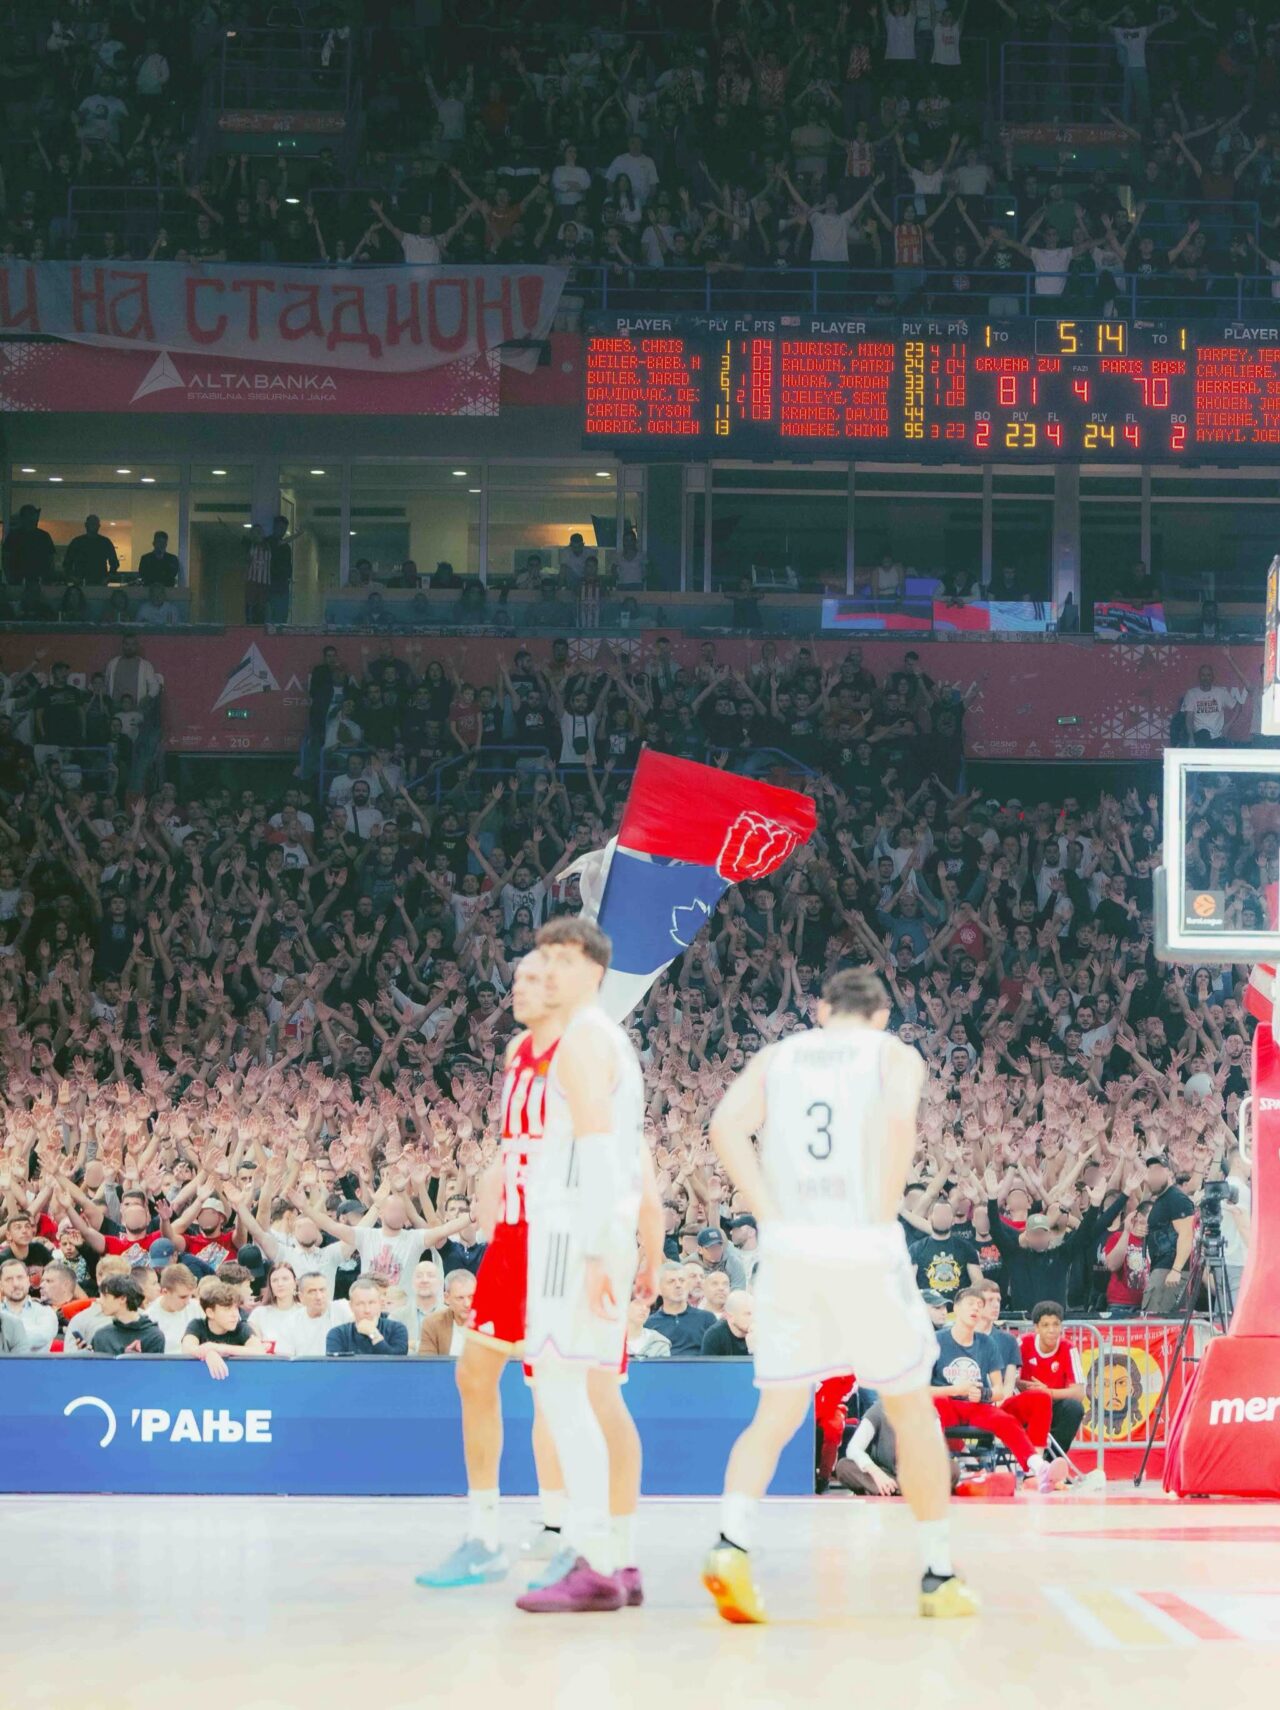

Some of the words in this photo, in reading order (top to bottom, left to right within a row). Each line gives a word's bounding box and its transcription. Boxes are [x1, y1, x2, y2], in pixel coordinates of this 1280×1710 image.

[617, 319, 671, 331] PLAYER
[709, 321, 728, 331] PLY
[735, 321, 748, 331] FL
[754, 321, 775, 331] PTS
[811, 322, 865, 333] PLAYER
[903, 324, 921, 335] PLY
[929, 324, 942, 335] FL
[948, 324, 968, 335] PTS
[986, 326, 990, 347] 1
[993, 332, 1008, 341] TO
[1152, 335, 1167, 344] TO
[1181, 329, 1185, 350] 1
[1225, 329, 1278, 339] PLAYER
[589, 339, 636, 352] JONES,
[642, 339, 683, 352] CHRIS
[753, 340, 771, 354] 04
[905, 343, 924, 357] 23
[952, 344, 965, 356] 11
[587, 355, 686, 369] WEILER-BABB,
[721, 356, 730, 370] 3
[753, 356, 771, 370] 03
[1197, 349, 1252, 362] TARPEY,
[782, 359, 845, 372] BALDWIN,
[905, 359, 924, 373] 24
[947, 360, 965, 374] 04
[976, 359, 1029, 372] CRVENA
[1102, 360, 1142, 373] PARIS
[1152, 362, 1185, 374] BASK
[1197, 365, 1276, 378] CAVALIERE,
[188, 374, 337, 389] ALTABANKA
[587, 372, 640, 384] BUTLER,
[647, 373, 689, 385] JARED
[720, 372, 729, 386] 6
[753, 373, 771, 387] 09
[782, 375, 831, 388] NWORA,
[838, 376, 888, 388] JORDAN
[906, 375, 923, 390] 33
[952, 376, 964, 390] 10
[1000, 376, 1036, 404] 81
[1074, 380, 1088, 402] 4
[1133, 378, 1167, 406] 70
[1197, 381, 1261, 394] HERRERA,
[753, 389, 770, 403] 05
[782, 391, 848, 404] OJELEYE,
[853, 392, 886, 405] SEMI
[906, 391, 924, 405] 37
[947, 392, 964, 406] 09
[1197, 397, 1252, 410] RHODEN,
[587, 404, 641, 417] CARTER,
[648, 405, 690, 418] TYSON
[716, 404, 729, 418] 11
[753, 405, 770, 419] 03
[781, 407, 840, 420] KRAMER,
[845, 408, 888, 420] DAVID
[905, 408, 924, 421] 44
[975, 412, 990, 420] BO
[1013, 412, 1028, 421] PLY
[1049, 412, 1059, 421] FL
[1092, 413, 1107, 422] PLY
[1126, 414, 1137, 423] FL
[1171, 415, 1186, 423] BO
[1197, 413, 1258, 426] ETIENNE,
[587, 420, 641, 433] DOBRIC,
[648, 421, 698, 434] OGNJEN
[716, 420, 729, 435] 13
[781, 423, 840, 437] MONEKE,
[845, 424, 888, 437] CHIMA
[905, 424, 923, 438] 95
[947, 424, 965, 438] 23
[977, 424, 989, 446] 2
[1006, 424, 1035, 447] 23
[1048, 425, 1059, 446] 4
[1085, 425, 1114, 448] 24
[1125, 427, 1137, 447] 4
[1173, 427, 1184, 448] 2
[1197, 429, 1245, 442] AYAYI,
[807, 1101, 832, 1160] 3
[131, 1408, 272, 1443] РАЊЕ
